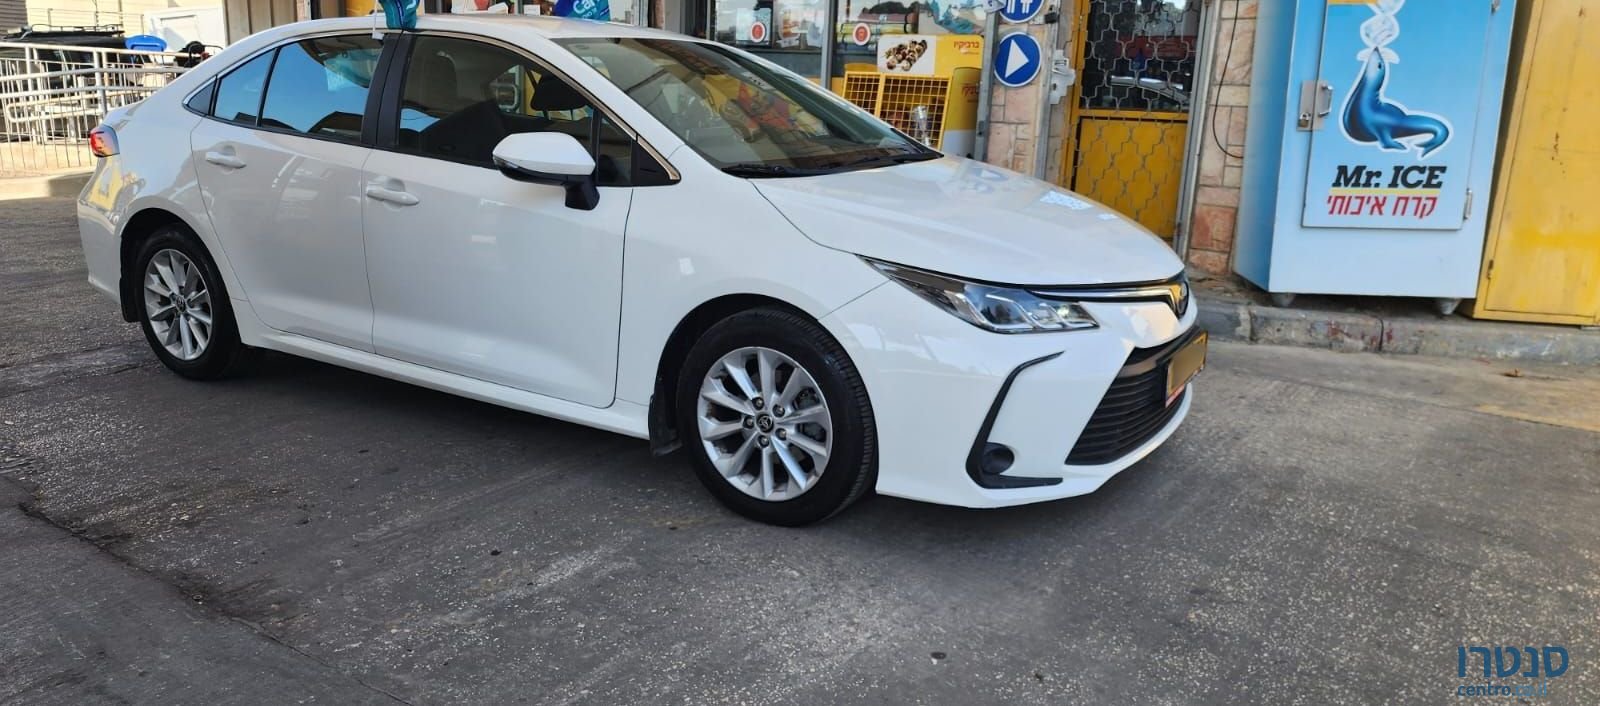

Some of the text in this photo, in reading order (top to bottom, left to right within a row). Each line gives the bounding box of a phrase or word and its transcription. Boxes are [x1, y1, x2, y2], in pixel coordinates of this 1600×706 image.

[1332, 165, 1447, 189] Mr. ICE
[1327, 195, 1438, 219] קרח איכותי
